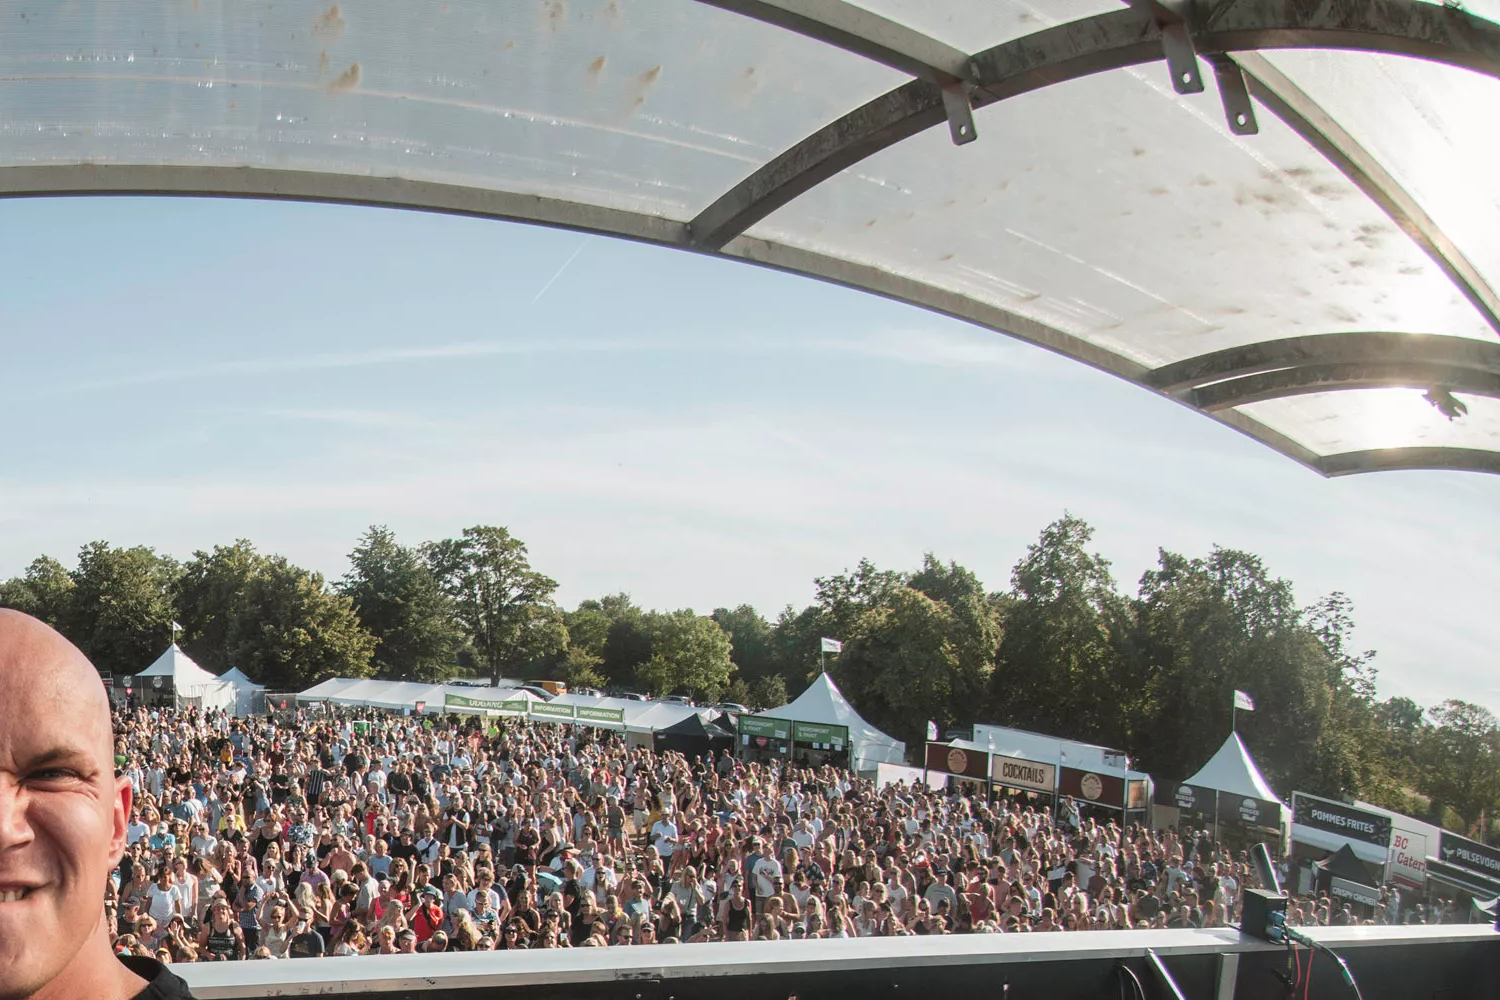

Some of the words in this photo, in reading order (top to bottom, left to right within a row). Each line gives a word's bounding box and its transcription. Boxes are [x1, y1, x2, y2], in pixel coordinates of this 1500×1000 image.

[534, 705, 571, 714] INFORMATION
[580, 710, 620, 719] INFORMATION
[1003, 763, 1044, 784] COCKTAILS
[1311, 809, 1346, 827] POMMES
[1347, 818, 1375, 834] FRITES
[1393, 834, 1409, 850] BC
